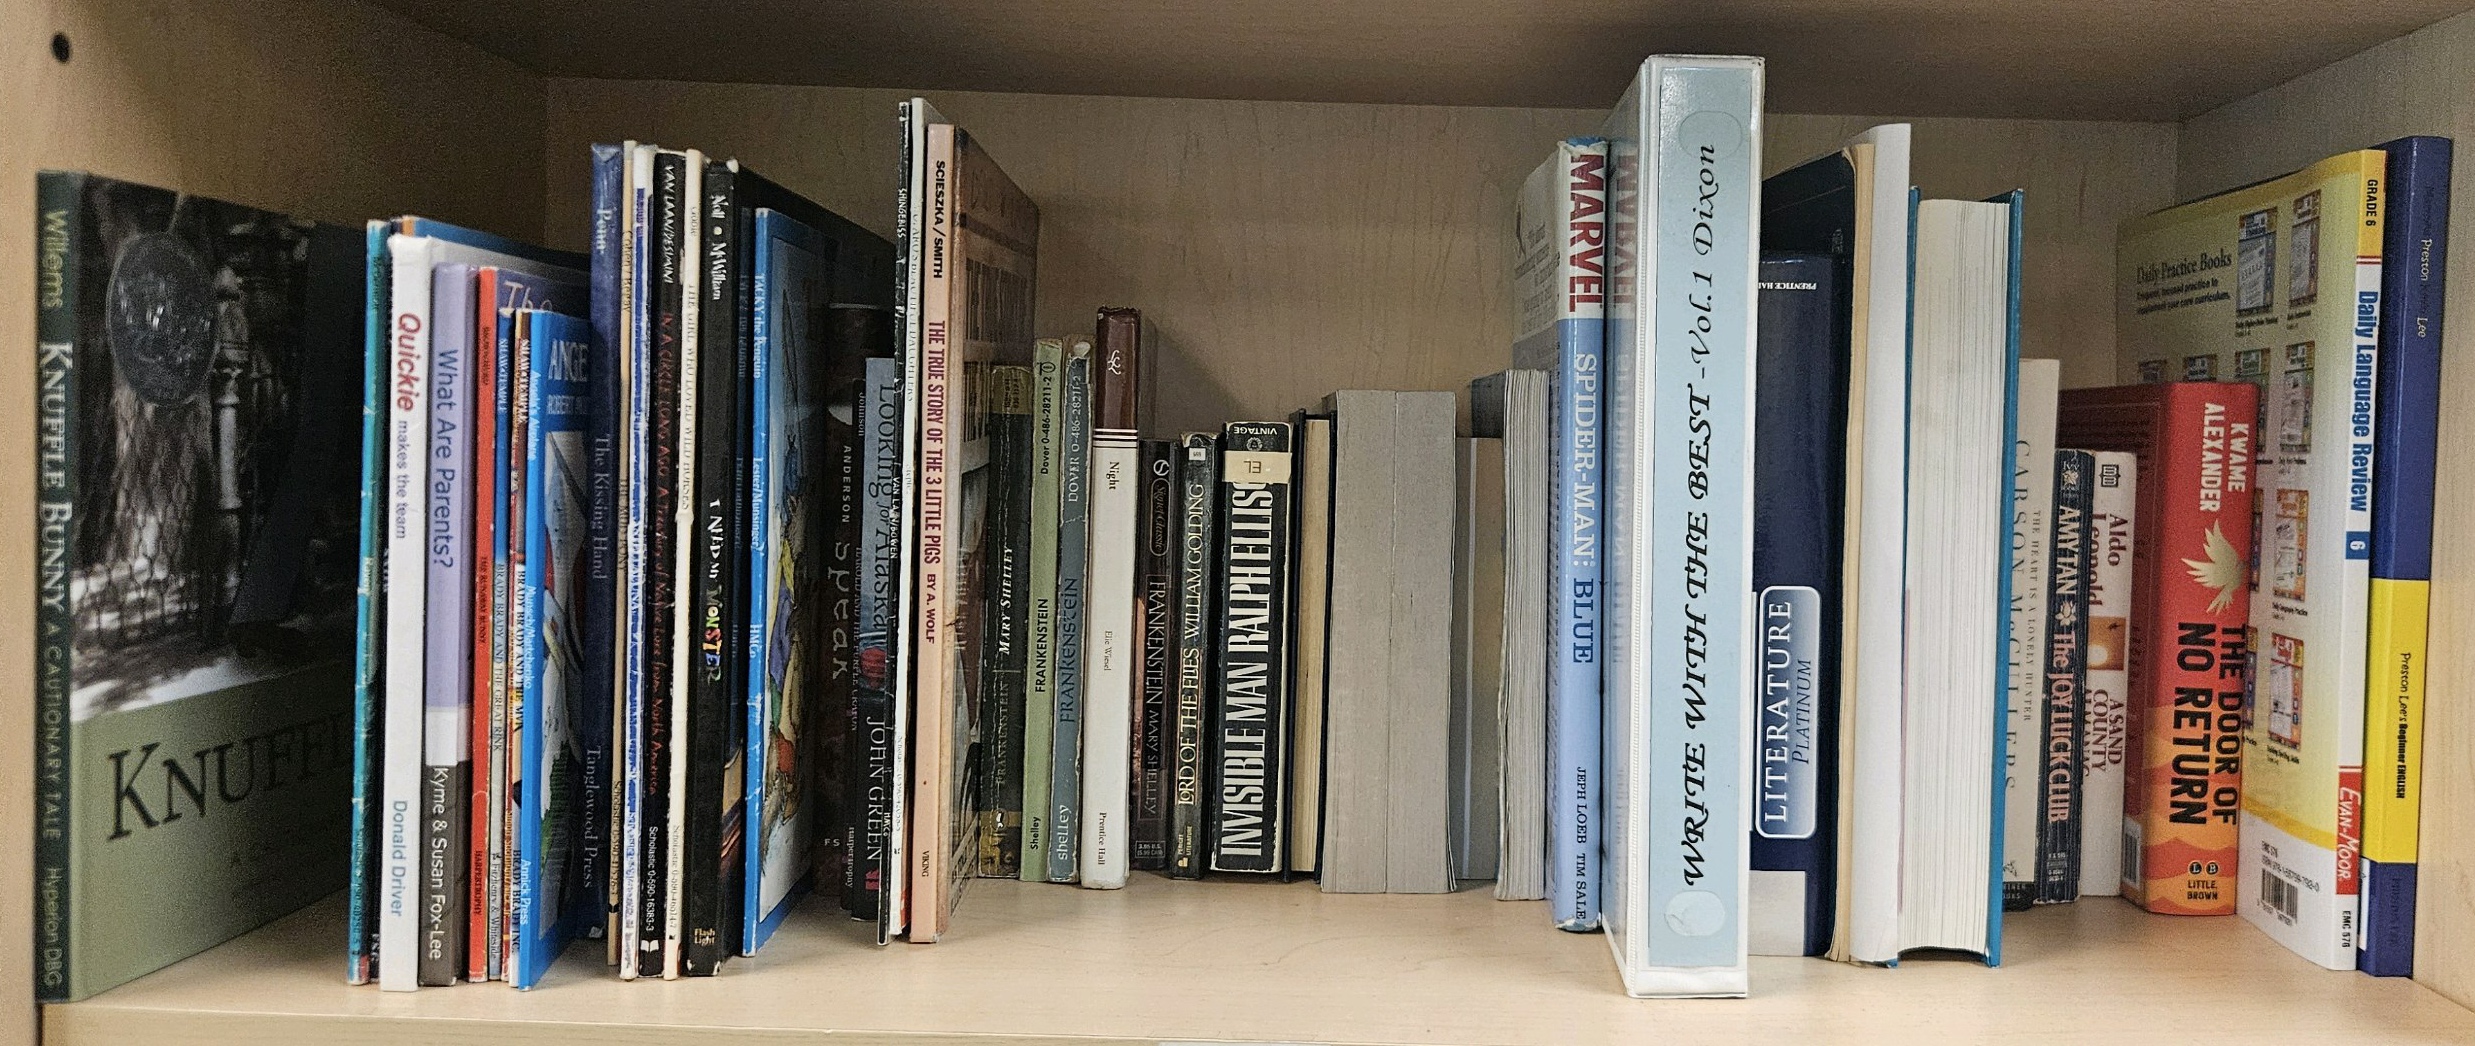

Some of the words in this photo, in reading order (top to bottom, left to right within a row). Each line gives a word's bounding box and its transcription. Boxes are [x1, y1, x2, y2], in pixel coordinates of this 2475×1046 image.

[663, 164, 675, 194] VAN
[1692, 143, 1719, 256] Dixon
[2365, 179, 2379, 217] GRADE
[709, 194, 729, 219] Noll
[2365, 218, 2377, 227] 6
[595, 208, 613, 250] Penn
[661, 195, 675, 284] LAAN/DESIMINI
[1569, 153, 1605, 313] MARVEL
[43, 209, 70, 309] Willems
[709, 242, 728, 300] McWilliam
[2161, 256, 2198, 280] Practice
[2199, 247, 2232, 271] Books
[2420, 238, 2433, 282] Preston
[753, 273, 765, 314] TACKY
[1774, 282, 1817, 290] PRENTICE
[753, 316, 766, 334] the
[927, 320, 946, 345] THE
[2354, 290, 2379, 340] Daily
[2416, 316, 2429, 338] Lee
[396, 312, 422, 412] Quickie
[658, 349, 673, 394] CIRCLE
[752, 335, 767, 379] Penguin
[927, 348, 945, 381] TRUE
[436, 348, 458, 411] What
[2351, 344, 2376, 438] Language
[39, 341, 73, 488] KNUFFLE
[926, 383, 945, 427] STORY
[1041, 376, 1052, 445] 0-486-28211-2
[1070, 375, 1082, 453] 0-486-28211-2
[396, 420, 411, 469] makes
[435, 418, 456, 458] Are
[594, 433, 612, 466] The
[868, 384, 896, 499] Looking
[926, 427, 943, 445] OF
[1233, 426, 1278, 435] VINTAGE
[925, 448, 943, 473] THE
[1040, 449, 1050, 474] Dover
[1068, 456, 1080, 503] DOVER
[1105, 461, 1120, 491] Night
[1243, 460, 1262, 474] EL
[1573, 353, 1598, 567] SPIDER-MAN:
[2199, 402, 2226, 513] ALEXANDER
[2228, 422, 2250, 494] KWAME
[2349, 443, 2373, 513] Review
[396, 473, 410, 498] the
[590, 472, 610, 530] Kissing
[750, 456, 763, 546] Lester/Munsinger
[841, 445, 852, 523] ANDERSON
[891, 476, 901, 496] VAN
[925, 476, 942, 486] 3
[395, 502, 409, 539] team
[433, 468, 456, 569] Parents?
[924, 488, 942, 532] LITTLE
[1187, 483, 1205, 564] GOLDING
[2011, 439, 2031, 576] CARSON
[2031, 510, 2041, 534] THE
[2057, 505, 2081, 553] AMY
[707, 515, 724, 560] NEED
[924, 534, 941, 565] PIGS
[1153, 515, 1166, 552] Classic
[1685, 511, 1709, 600] THE
[2107, 513, 2129, 567] Aldo
[2349, 540, 2366, 551] 6
[40, 501, 73, 614] BUNNY
[592, 535, 609, 580] Hand
[872, 529, 892, 630] Alaska
[1000, 547, 1013, 610] SHELLEY
[2029, 540, 2040, 582] HEART
[2056, 553, 2079, 595] TAN
[2089, 512, 2108, 607] Leopold
[494, 563, 505, 601] BRADY
[926, 593, 936, 606] A.
[927, 573, 936, 591] BY
[1184, 565, 1203, 640] WILLIAM
[2029, 587, 2038, 600] IS
[42, 621, 61, 636] A
[494, 602, 505, 641] BRADY
[827, 541, 852, 681] speak
[925, 608, 935, 644] WOLF
[1227, 565, 1271, 653] RALPH
[1572, 577, 1595, 664] BLUE
[494, 641, 505, 662] AND
[523, 584, 537, 690] Munsch/Martchenko
[702, 583, 723, 687] MONSTER
[749, 623, 763, 659] HMCo
[999, 614, 1012, 656] MARY
[1035, 598, 1049, 693] FRANKENSTEIN
[1104, 630, 1113, 645] Elie
[1145, 581, 1166, 705] FRANKENSTEIN
[2025, 618, 2036, 666] LONELY
[2053, 631, 2076, 669] The
[2175, 621, 2217, 673] NO
[2218, 624, 2247, 681] THE
[493, 668, 504, 687] THE
[1103, 646, 1113, 671] Wiesel
[1182, 647, 1199, 690] FLIES
[1682, 603, 1707, 731] WITH
[2400, 652, 2412, 693] Preston
[1225, 661, 1268, 722] MAN
[1764, 601, 1791, 823] LITERATURE
[2023, 672, 2034, 722] HUNTER
[2048, 672, 2075, 710] JOY
[2109, 698, 2125, 711] A
[2398, 695, 2410, 722] Lee's
[43, 646, 62, 783] CAUTIONARY
[650, 698, 663, 736] North
[1146, 709, 1159, 752] MARY
[1180, 693, 1198, 735] THE
[2092, 688, 2109, 773] COUNTY
[2213, 691, 2245, 775] DOOR
[866, 716, 887, 779] JOHN
[1179, 737, 1197, 763] OF
[2049, 710, 2074, 768] LUCK
[2107, 713, 2125, 766] SAND
[2167, 686, 2214, 826] RETURN
[2396, 723, 2408, 764] Beginner
[649, 740, 664, 796] America
[1144, 754, 1158, 815] SHELLEY
[1178, 766, 1196, 806] LORD
[1576, 766, 1587, 800] JEPH
[2395, 764, 2406, 799] ENGLISH
[430, 766, 449, 816] Kyme
[584, 746, 602, 840] Tanglewood
[1220, 728, 1266, 857] INVISIBLE
[2047, 768, 2072, 823] CLUB
[2211, 786, 2239, 826] OF
[42, 791, 61, 839] TALE
[390, 799, 410, 861] Donald
[431, 819, 448, 834] &
[866, 785, 883, 861] GREEN
[1030, 816, 1042, 850] Shelley
[1056, 804, 1073, 861] shelley
[1098, 812, 1107, 847] Prentice
[1576, 804, 1588, 845] LOEB
[1680, 742, 1708, 887] WRITE
[430, 836, 448, 889] Susan
[511, 849, 522, 887] BRADY
[583, 846, 599, 889] Press
[647, 826, 659, 869] Scholastic
[921, 850, 930, 877] VIKING
[1097, 848, 1106, 866] Hall
[1575, 852, 1586, 877] TIM
[389, 866, 409, 917] Driver
[519, 858, 532, 896] Annick
[2187, 890, 2219, 901] BROWN
[41, 866, 62, 945] Hyperion
[511, 889, 522, 928] BRADY
[519, 897, 531, 925] Press
[1575, 880, 1587, 921] SALE
[2341, 910, 2352, 930] EMC
[428, 894, 446, 961] Fox-Lee
[489, 915, 500, 960] Whiteside
[2341, 932, 2351, 949] 576
[42, 947, 62, 988] DBG
